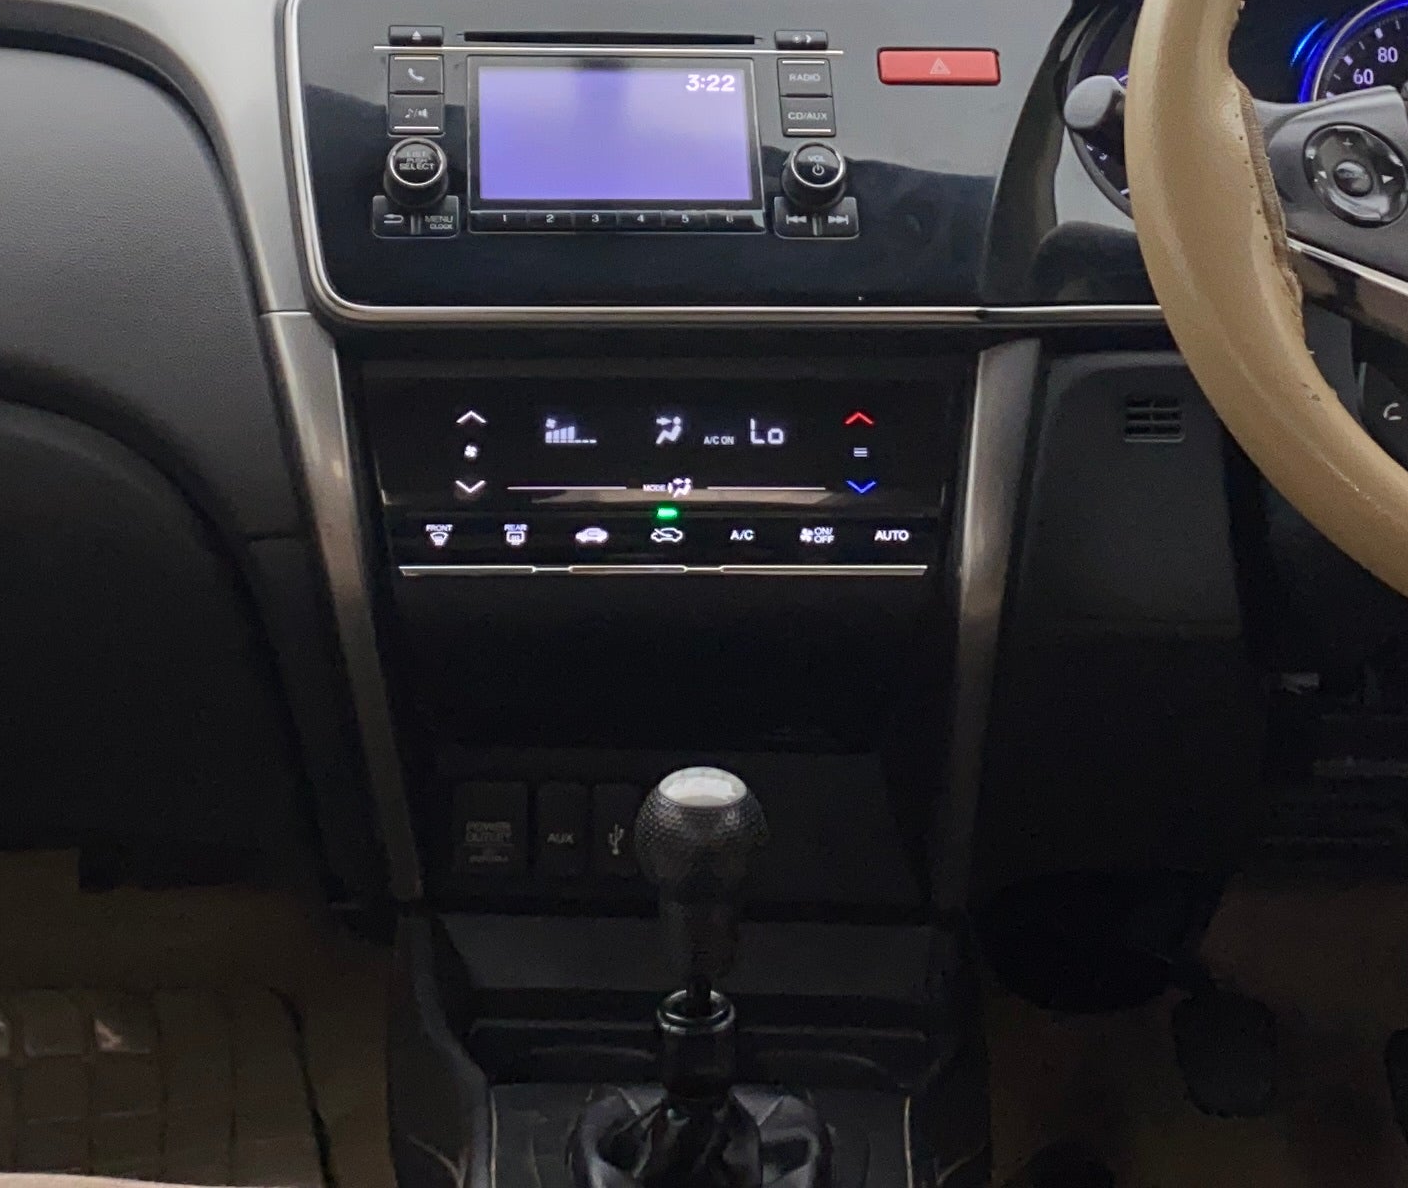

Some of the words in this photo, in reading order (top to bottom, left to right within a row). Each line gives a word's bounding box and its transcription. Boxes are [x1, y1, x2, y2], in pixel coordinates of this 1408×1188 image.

[1377, 47, 1398, 63] 80
[789, 73, 821, 82] RADIO
[1353, 68, 1374, 85] 60
[685, 73, 735, 92] 3:22
[788, 111, 827, 121] CD/AUX
[399, 162, 435, 171] SELECT
[425, 215, 454, 224] MENU
[750, 418, 784, 444] Lo
[704, 436, 719, 446] A/C
[721, 436, 734, 446] ON
[643, 483, 666, 492] MODE
[730, 529, 754, 541] A/C
[814, 527, 833, 536] ON/
[874, 529, 909, 541] AUTO
[814, 535, 834, 544] OFF
[547, 832, 575, 844] AUX
